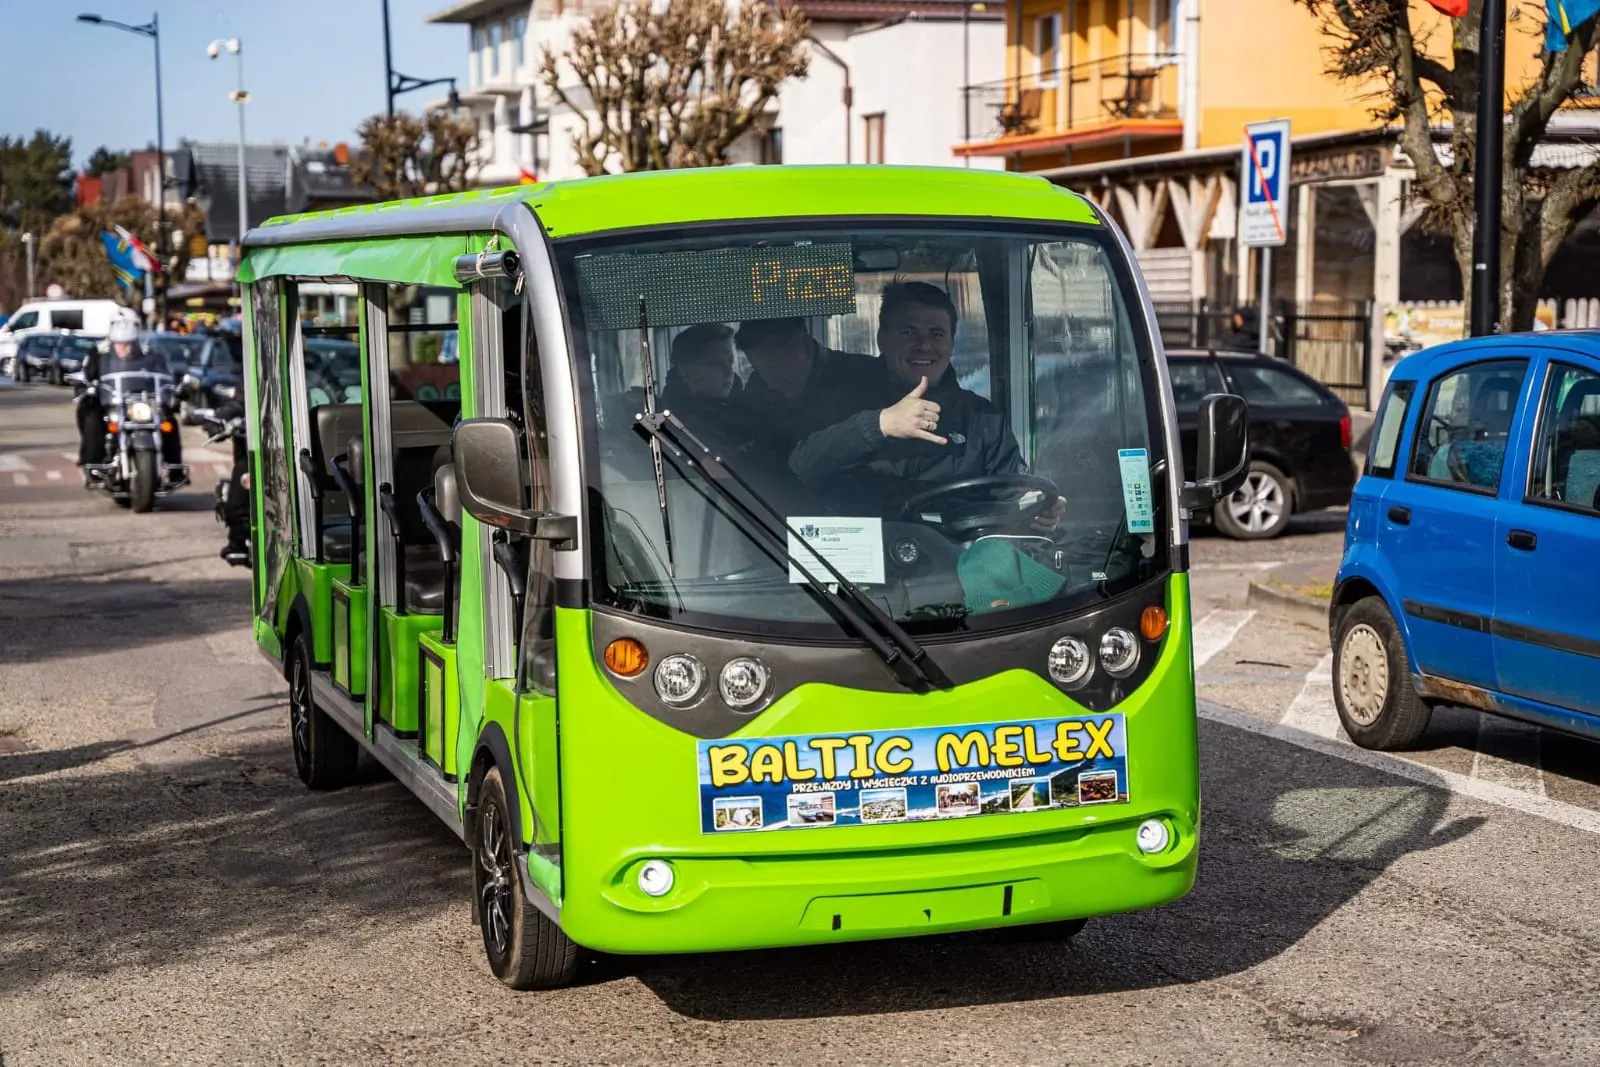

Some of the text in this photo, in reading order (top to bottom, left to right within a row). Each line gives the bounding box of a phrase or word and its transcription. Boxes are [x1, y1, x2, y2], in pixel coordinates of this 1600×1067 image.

[1254, 139, 1276, 196] P
[752, 261, 855, 304] Prze
[708, 718, 1115, 787] BALTIC MELEX
[792, 781, 851, 793] PRZEJAZDY
[862, 778, 918, 788] WYCIECZKI
[921, 776, 928, 785] Z
[930, 767, 1036, 784] AUDIOPRZEWODNIKIEM
